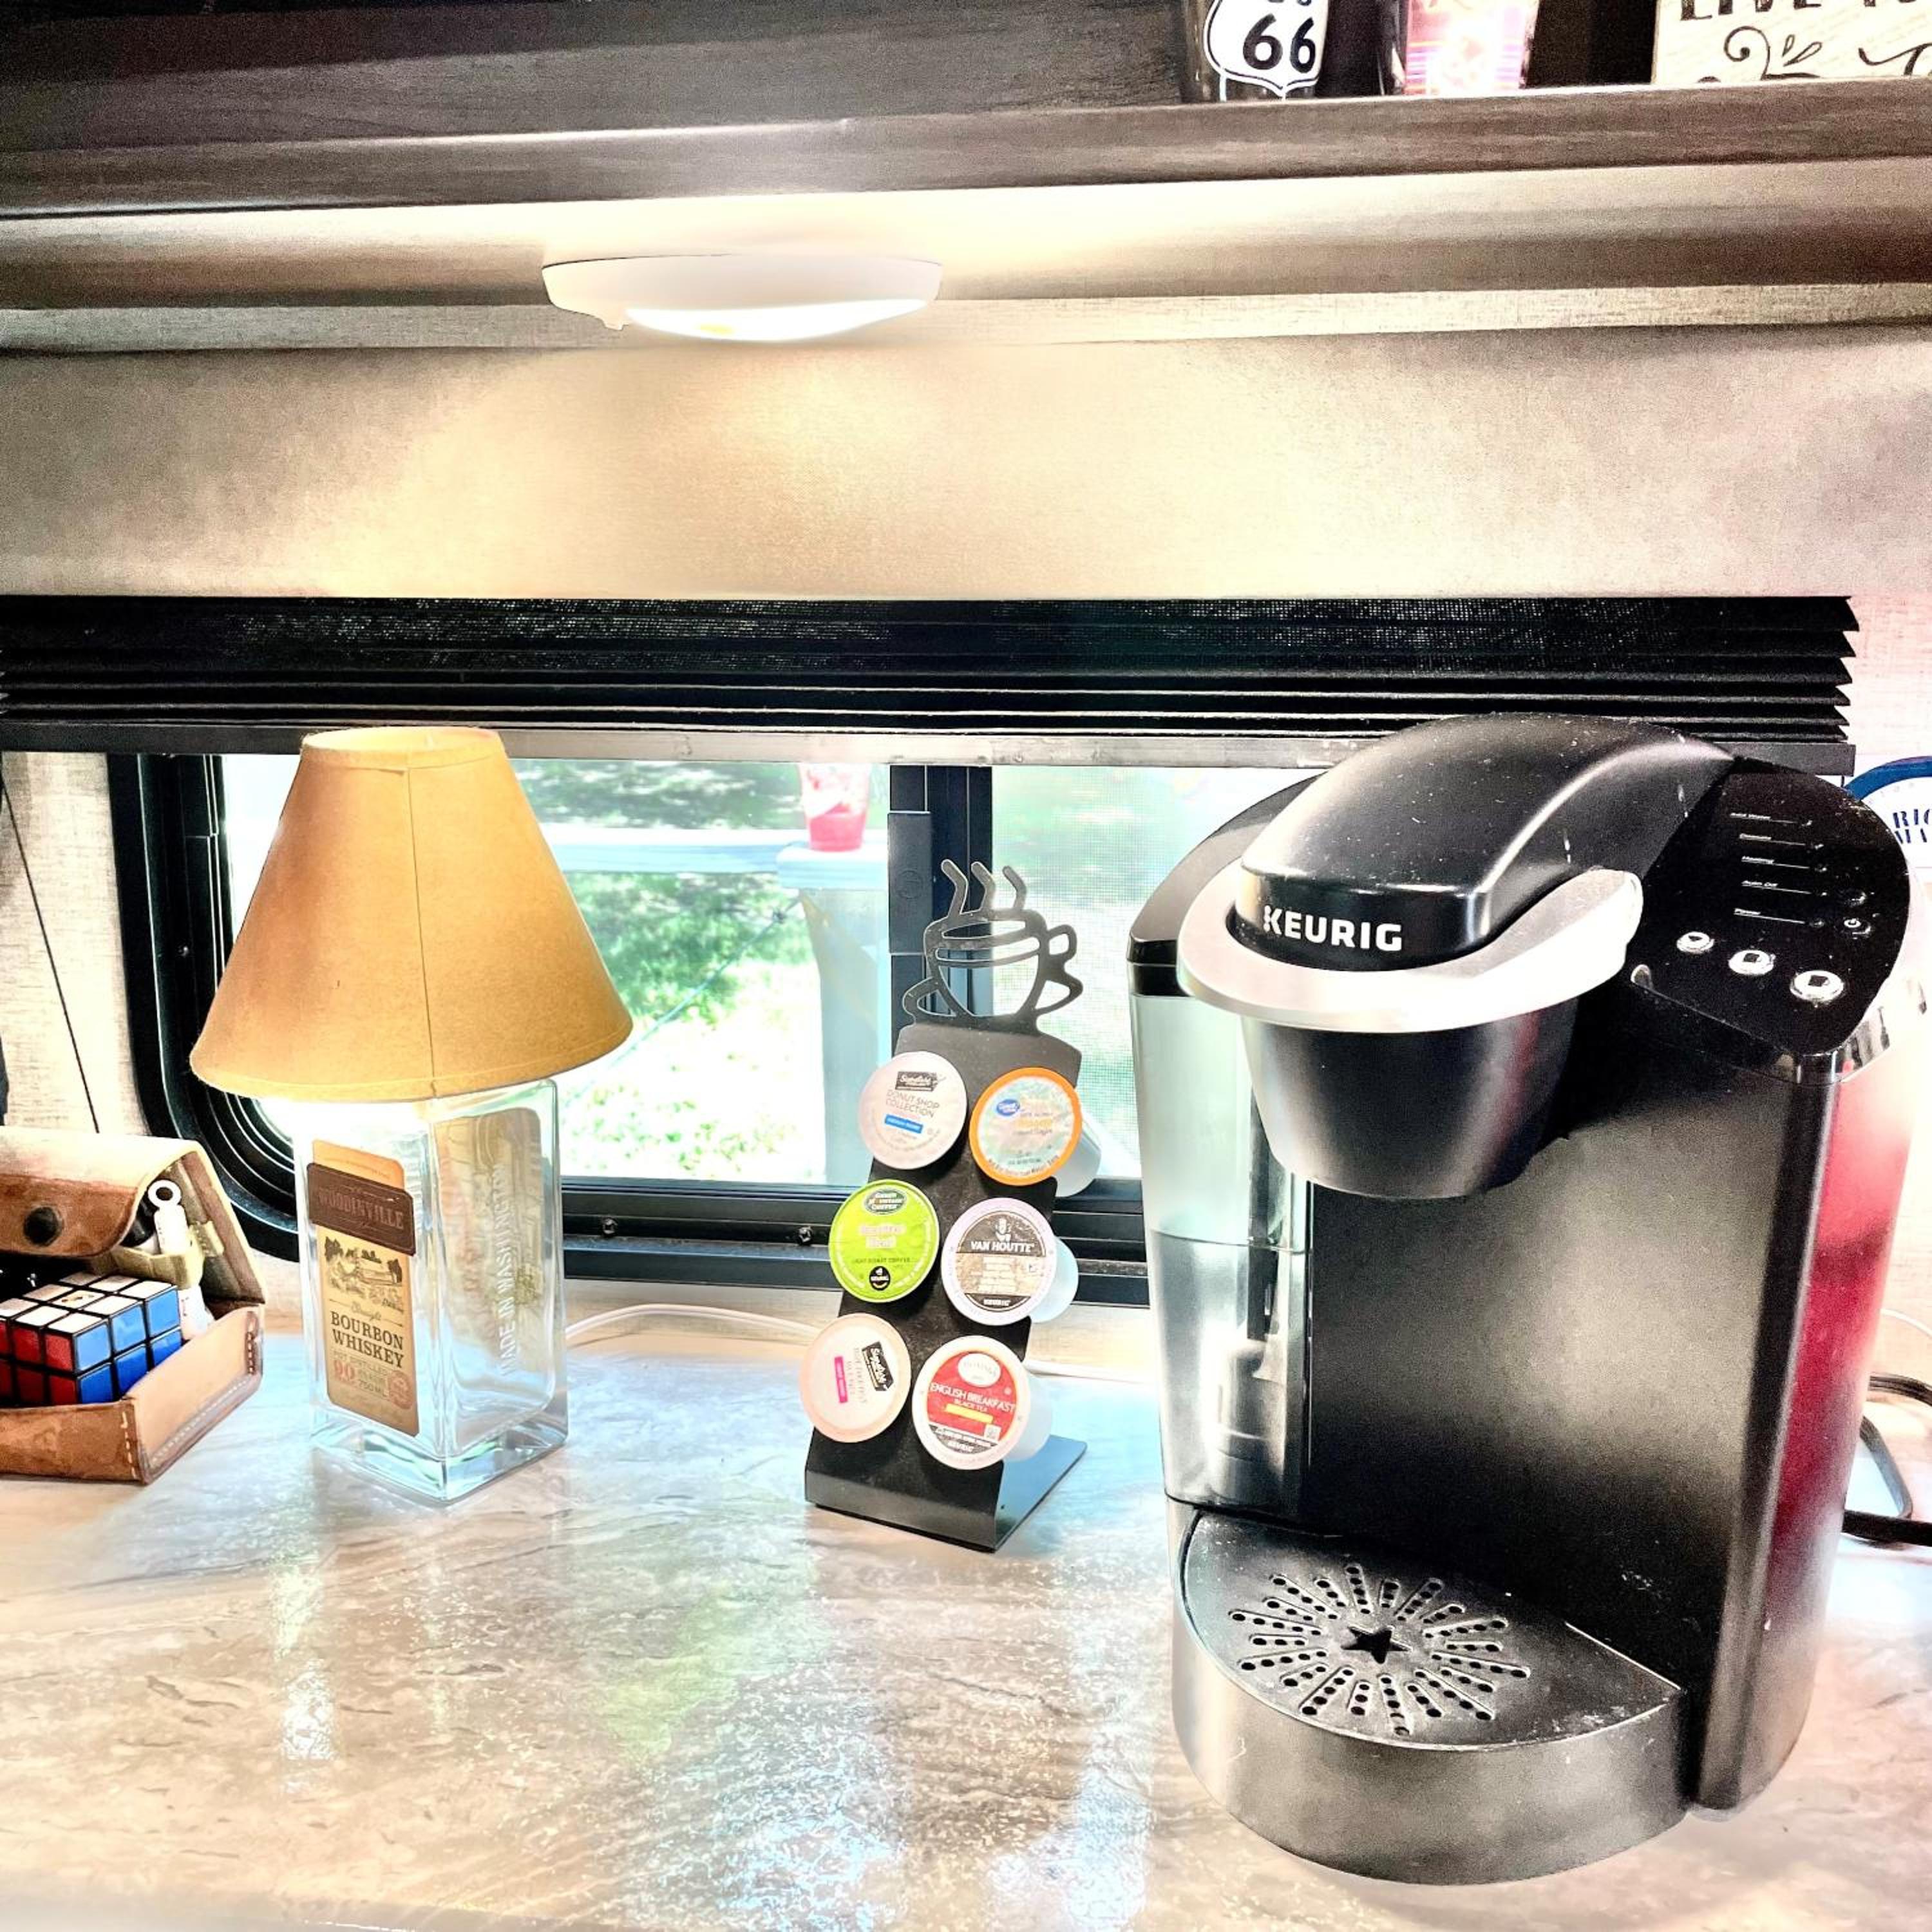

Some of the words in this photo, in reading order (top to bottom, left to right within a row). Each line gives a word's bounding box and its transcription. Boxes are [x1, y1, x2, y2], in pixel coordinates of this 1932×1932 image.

[1243, 13, 1316, 73] 66
[1263, 905, 1402, 951] KEURIG
[886, 1098, 934, 1118] COLLECTION
[971, 1241, 990, 1251] VAN
[992, 1242, 1032, 1253] HOUTTE
[330, 1311, 404, 1350] BOURBON
[332, 1329, 404, 1368] WHISKEY
[930, 1383, 967, 1399] ENGLISH
[967, 1392, 1016, 1412] BREAKFAST
